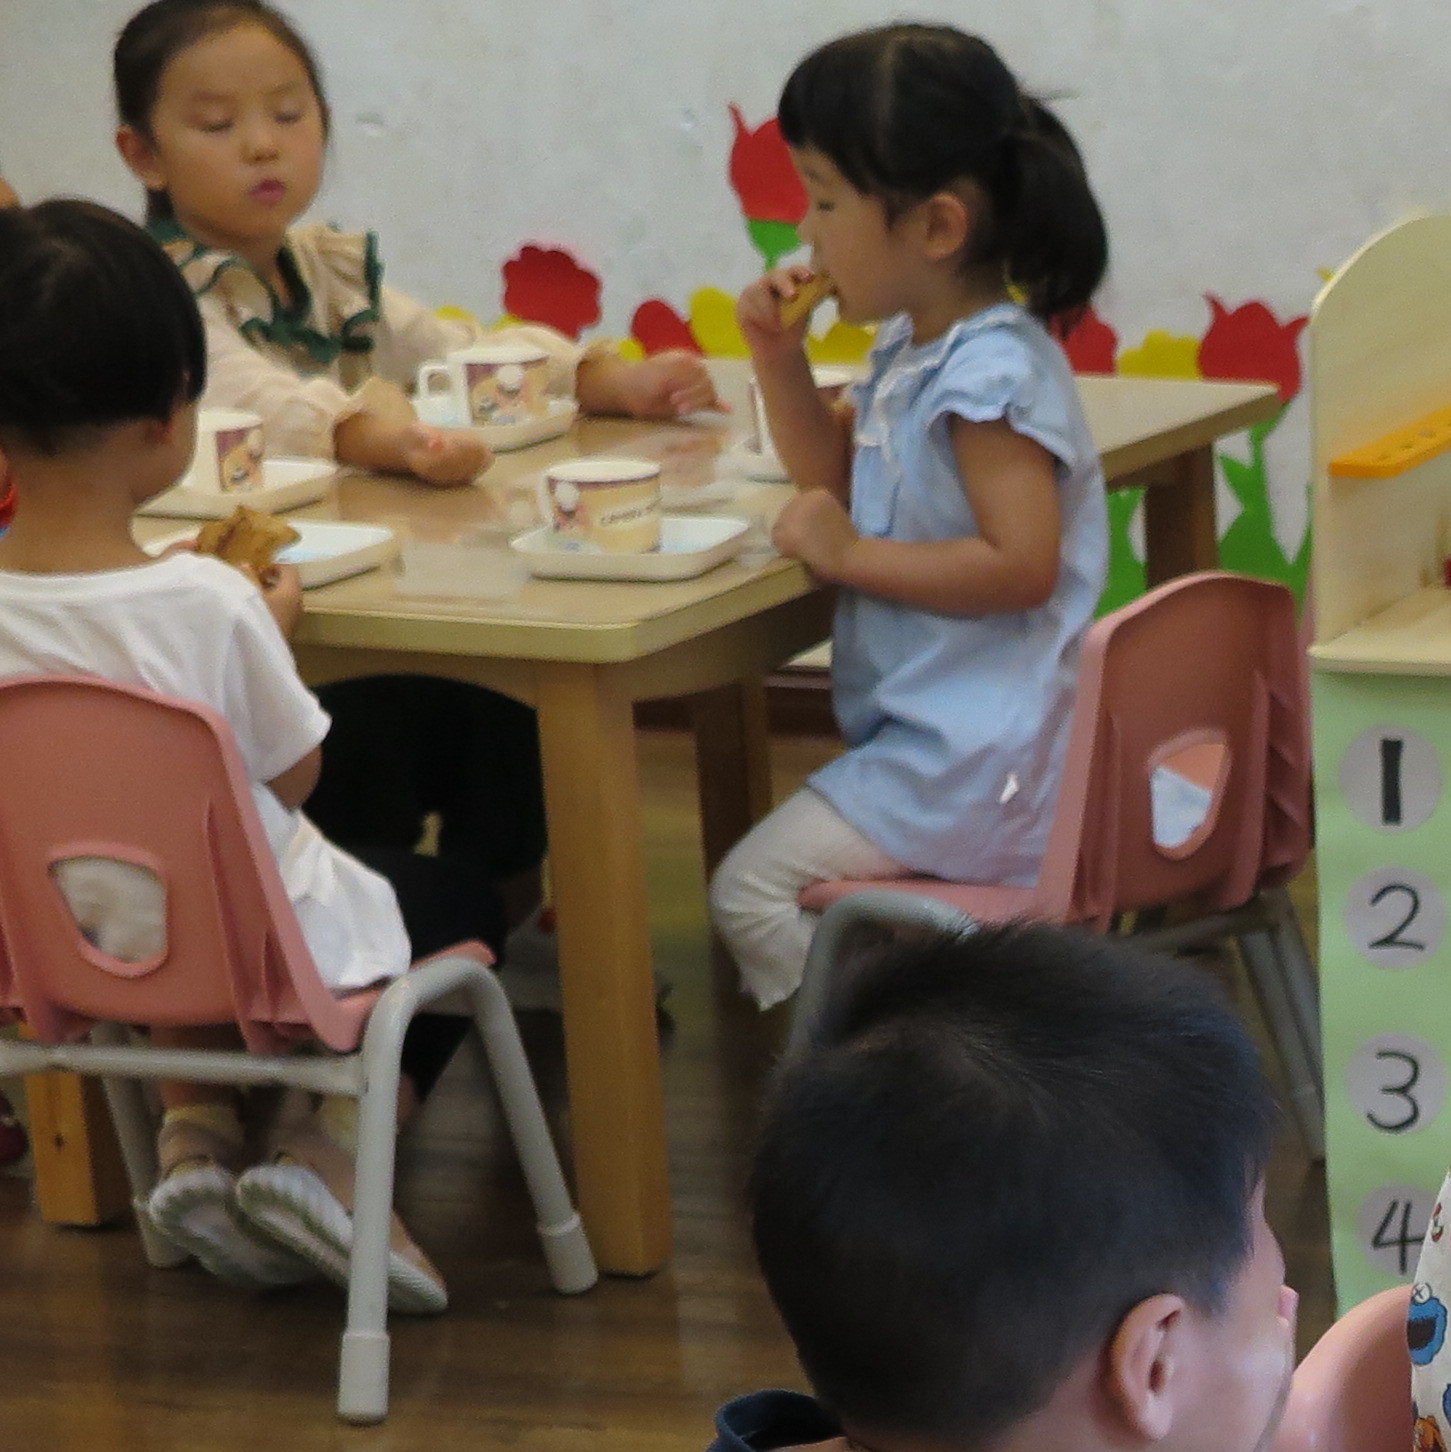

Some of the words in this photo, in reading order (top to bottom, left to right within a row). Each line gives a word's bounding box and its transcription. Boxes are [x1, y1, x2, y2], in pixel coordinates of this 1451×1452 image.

[1379, 737, 1404, 826] 1
[1368, 883, 1425, 951] 2
[1366, 1050, 1420, 1135] 3
[1371, 1199, 1425, 1275] 4
